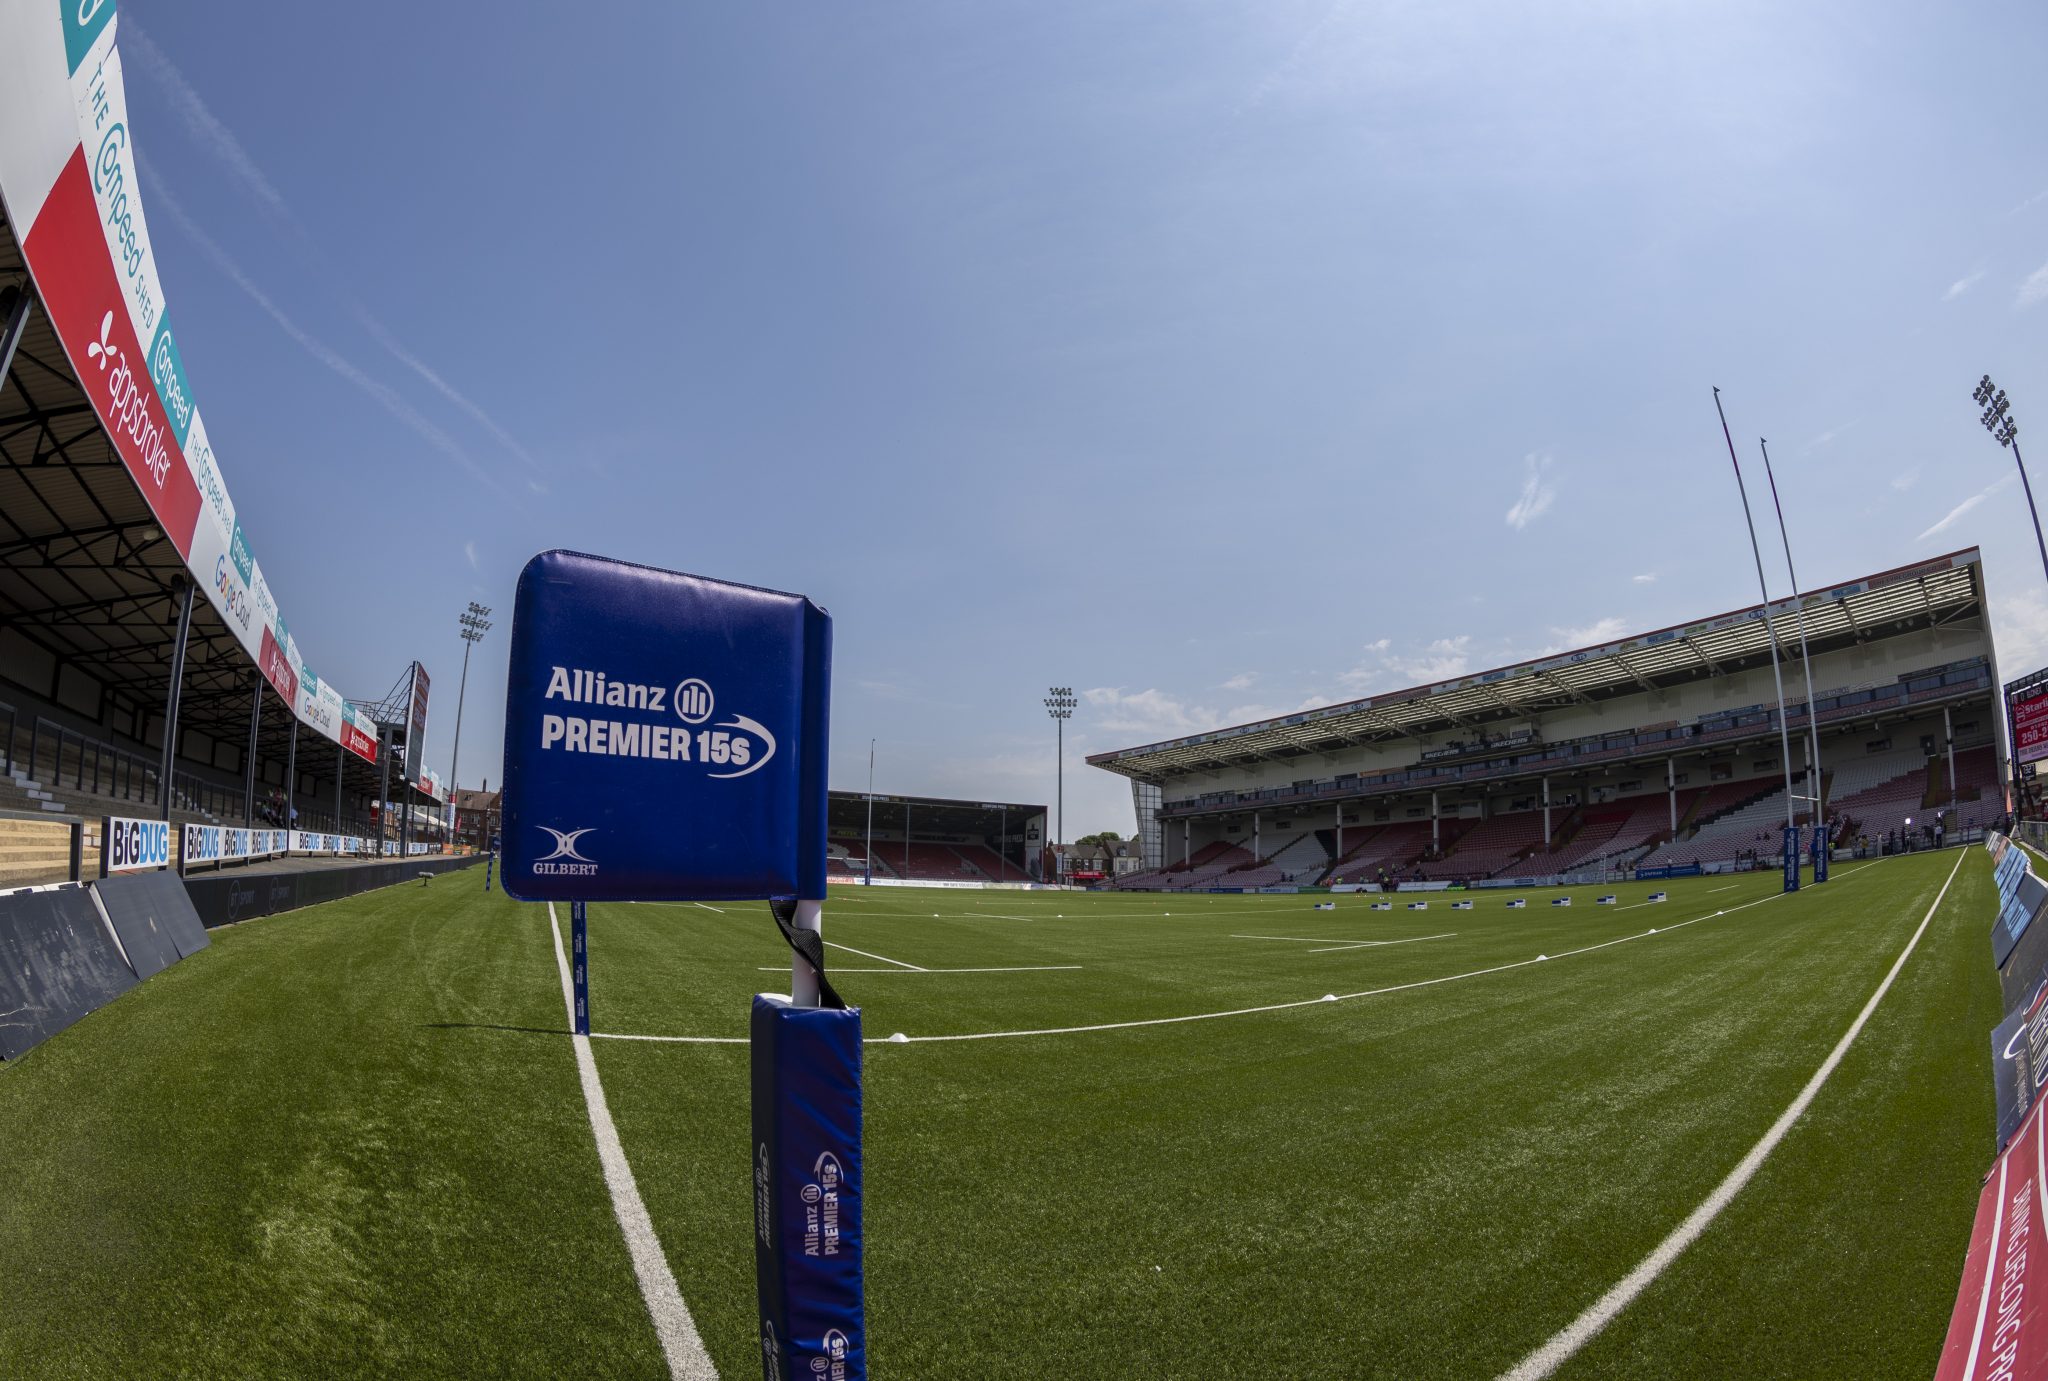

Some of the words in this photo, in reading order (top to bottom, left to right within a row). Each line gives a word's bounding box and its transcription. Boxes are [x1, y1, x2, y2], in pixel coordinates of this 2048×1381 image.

[89, 61, 109, 130] THE
[95, 122, 144, 278] Compeed
[135, 274, 154, 329] SHED
[153, 330, 191, 429] Compeed
[109, 352, 171, 489] appsbroker
[216, 554, 236, 613] Google
[236, 590, 251, 631] Cloud
[545, 666, 666, 711] Allianz
[541, 714, 691, 761] PREMIER
[697, 731, 751, 766] 15s
[532, 863, 598, 876] GILBERT
[823, 1163, 838, 1190] 15s
[805, 1206, 819, 1256] Allianz
[824, 1192, 839, 1255] PREMIER
[2007, 1177, 2032, 1254] DRIVING
[1992, 1239, 2028, 1353] LIFELONG
[832, 1338, 844, 1360] 15s
